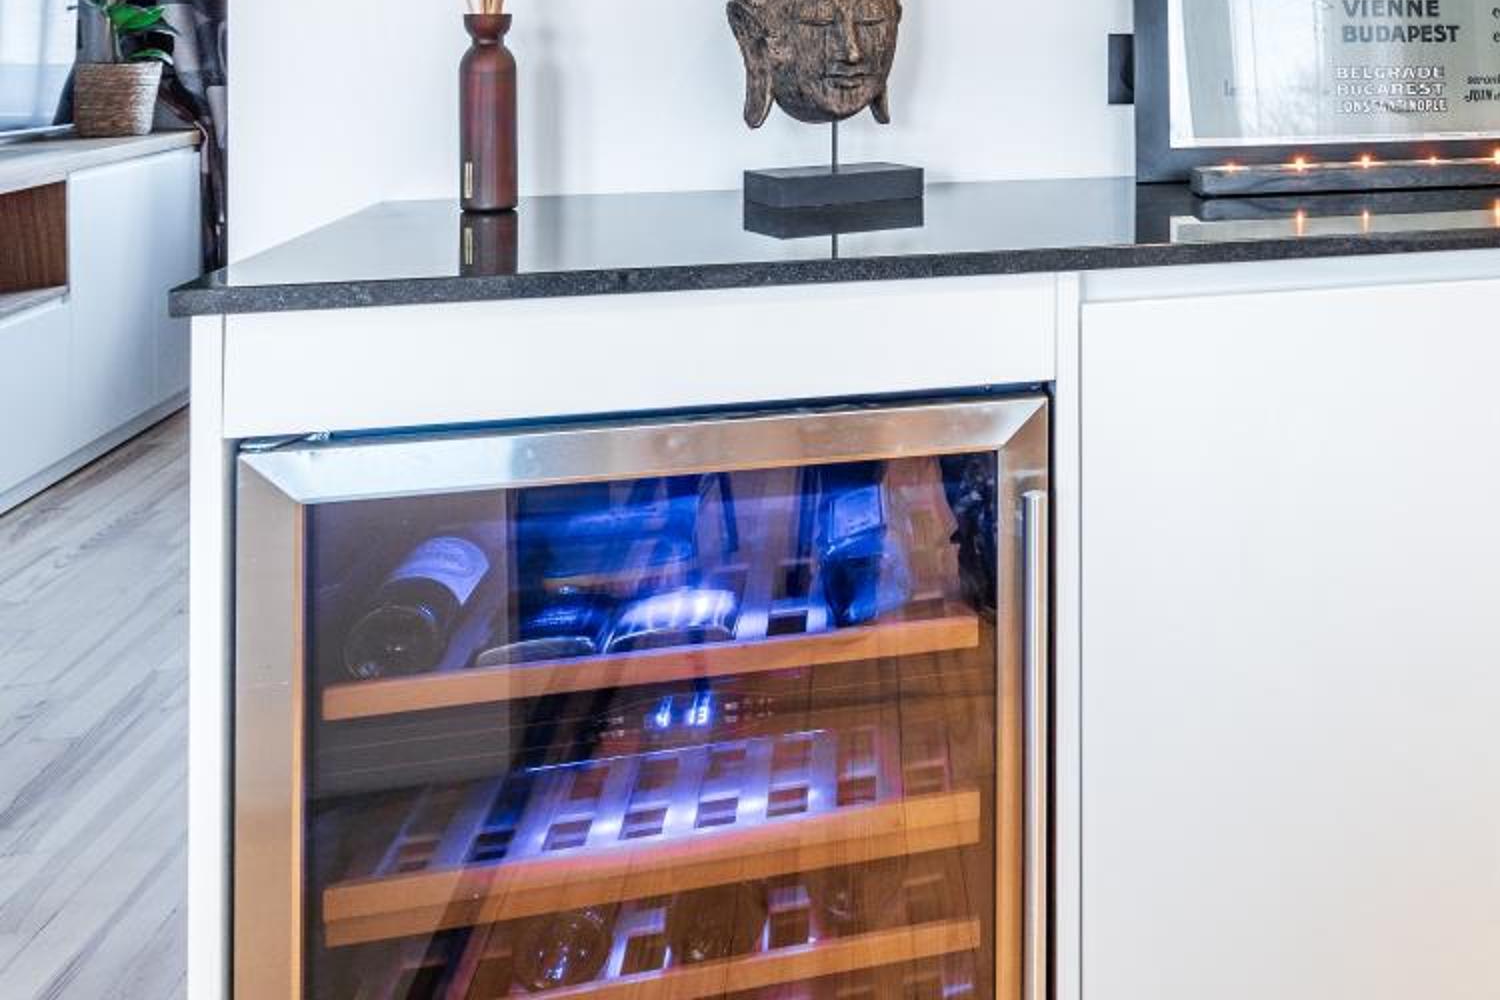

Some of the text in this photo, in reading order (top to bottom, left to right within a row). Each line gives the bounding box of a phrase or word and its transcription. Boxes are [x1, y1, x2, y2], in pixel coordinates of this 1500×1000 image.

[1343, 0, 1440, 18] VIENNE
[1342, 24, 1460, 44] BUDAPEST
[1335, 65, 1446, 80] BELGRADE
